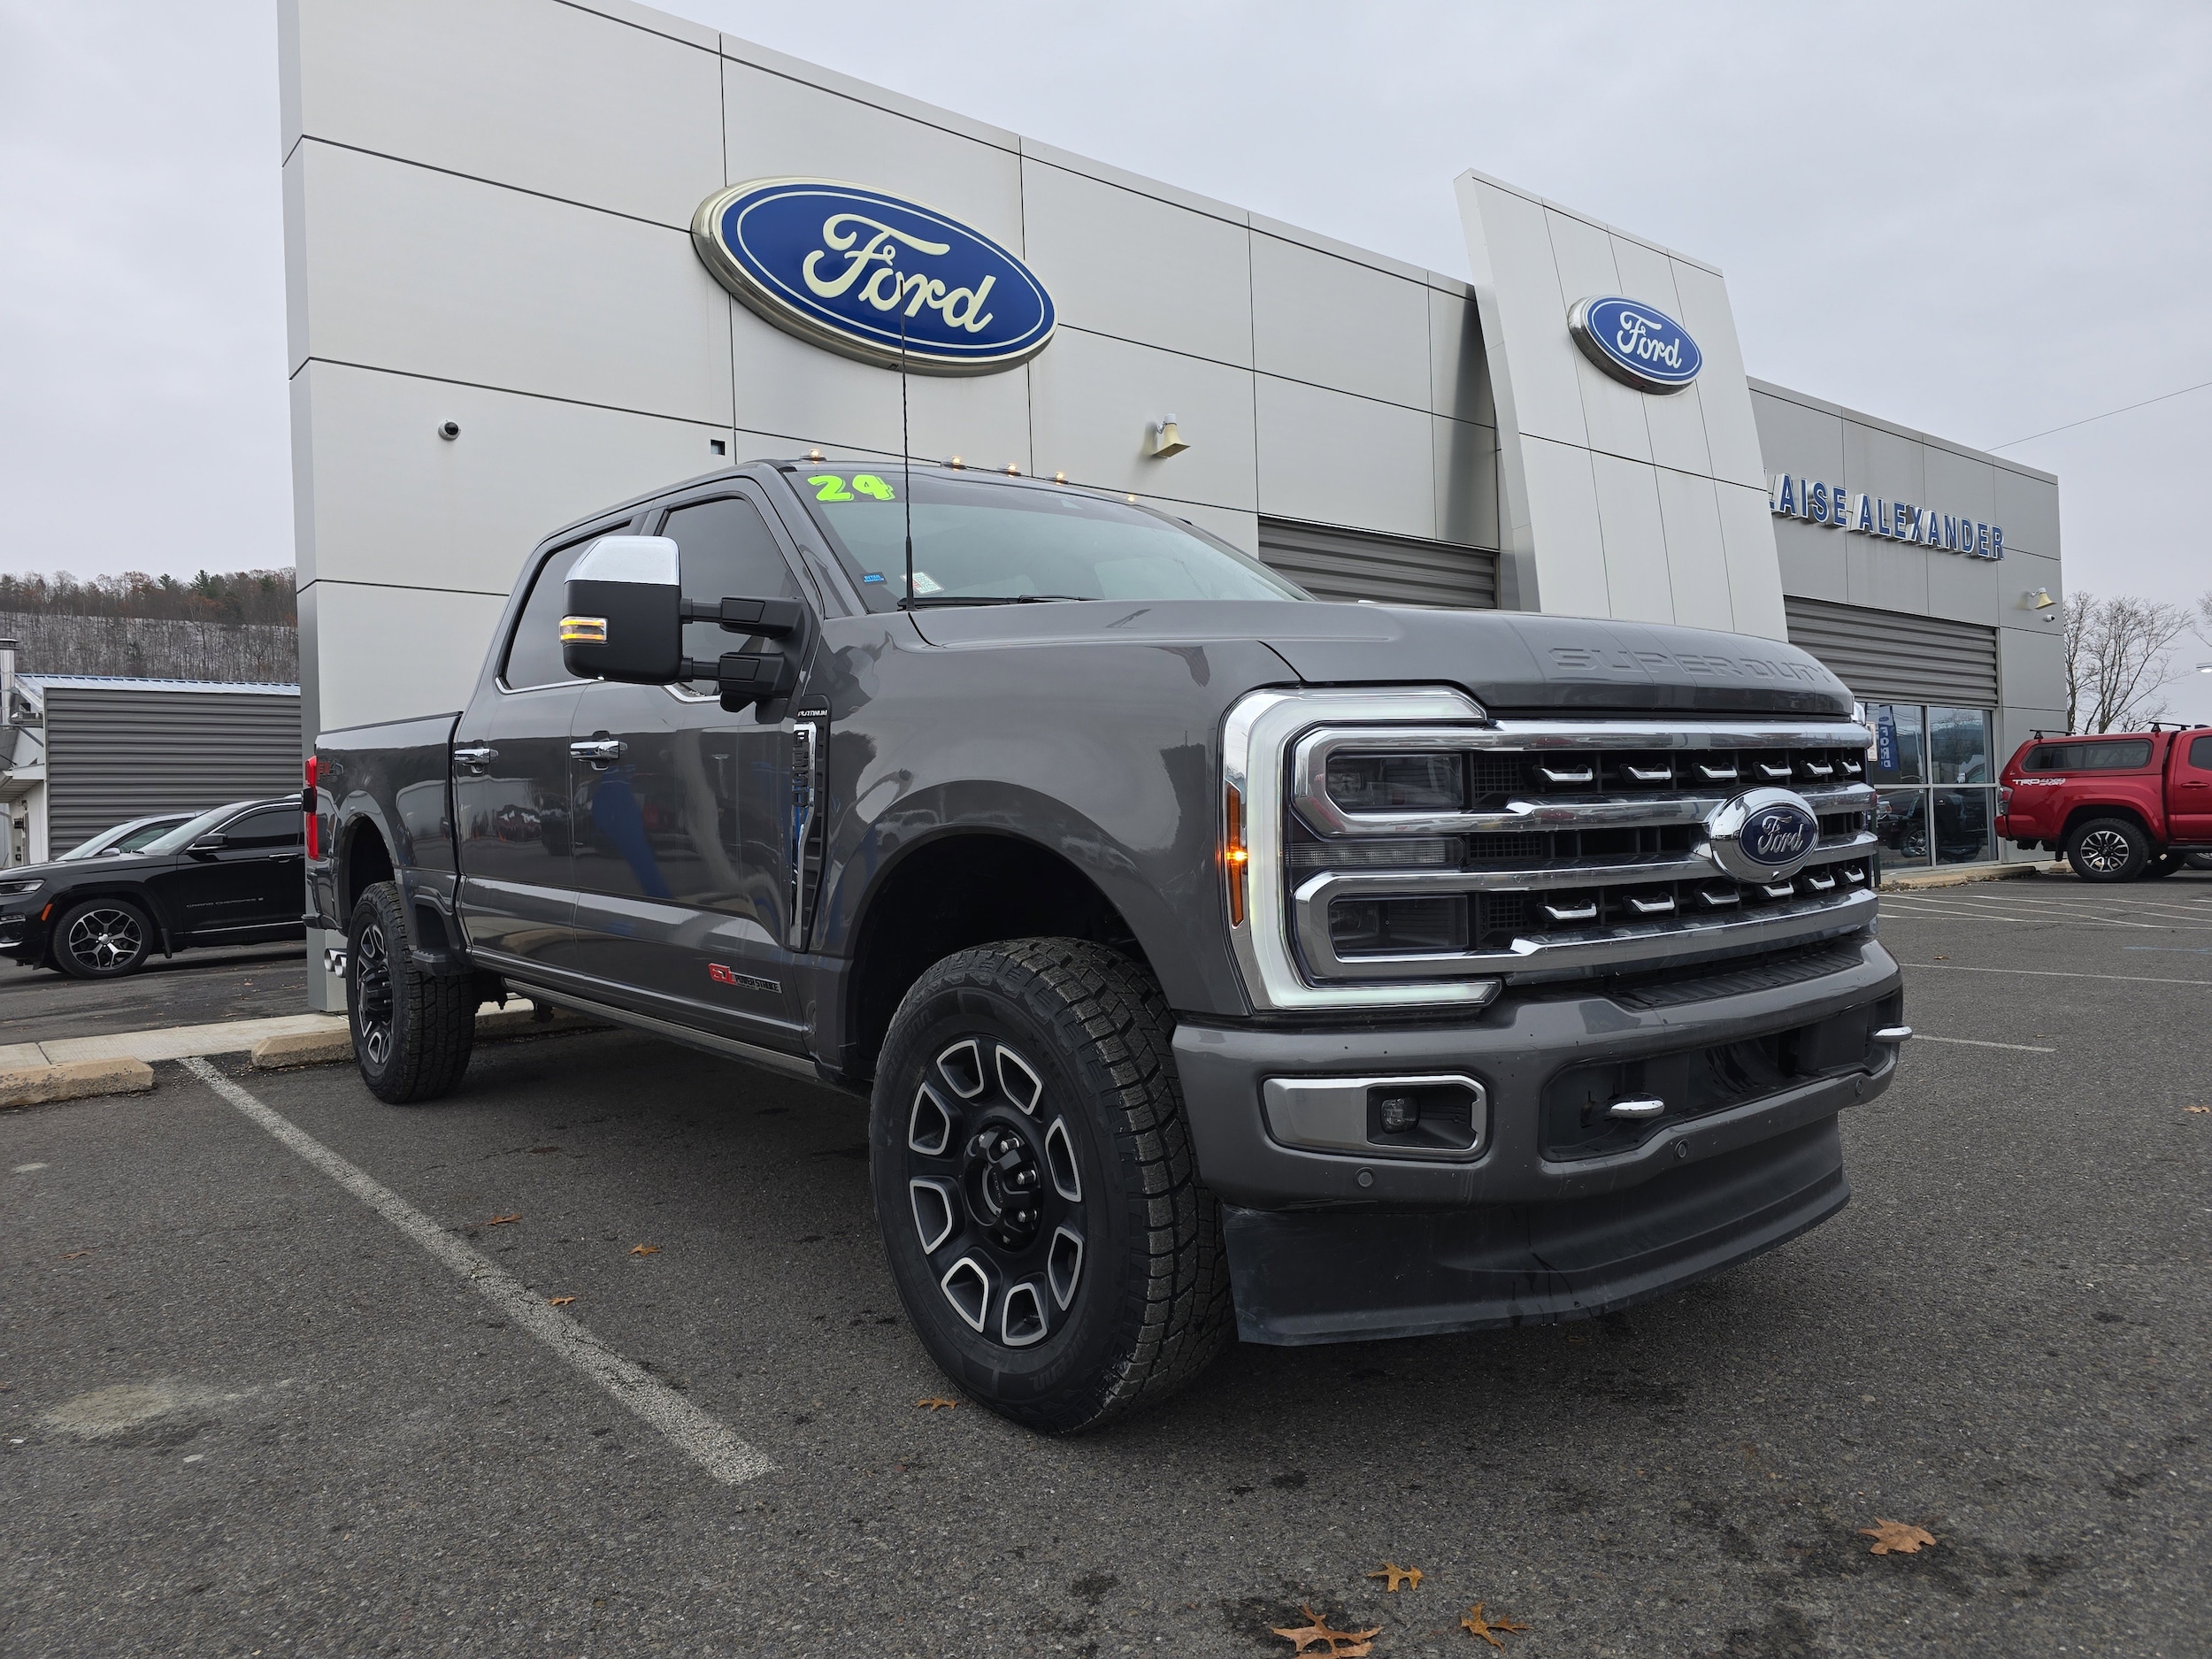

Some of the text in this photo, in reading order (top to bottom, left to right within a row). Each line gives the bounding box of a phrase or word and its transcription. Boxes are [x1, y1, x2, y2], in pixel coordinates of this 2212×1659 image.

[803, 213, 996, 333] Ford
[1617, 311, 1682, 368] Ford
[807, 474, 895, 501] 24
[1857, 493, 2004, 560] ALEXANDER
[1548, 647, 1742, 680] SUPER
[797, 709, 828, 718] PLATINUM
[2012, 778, 2040, 787] TRD
[1757, 815, 1804, 856] Ford
